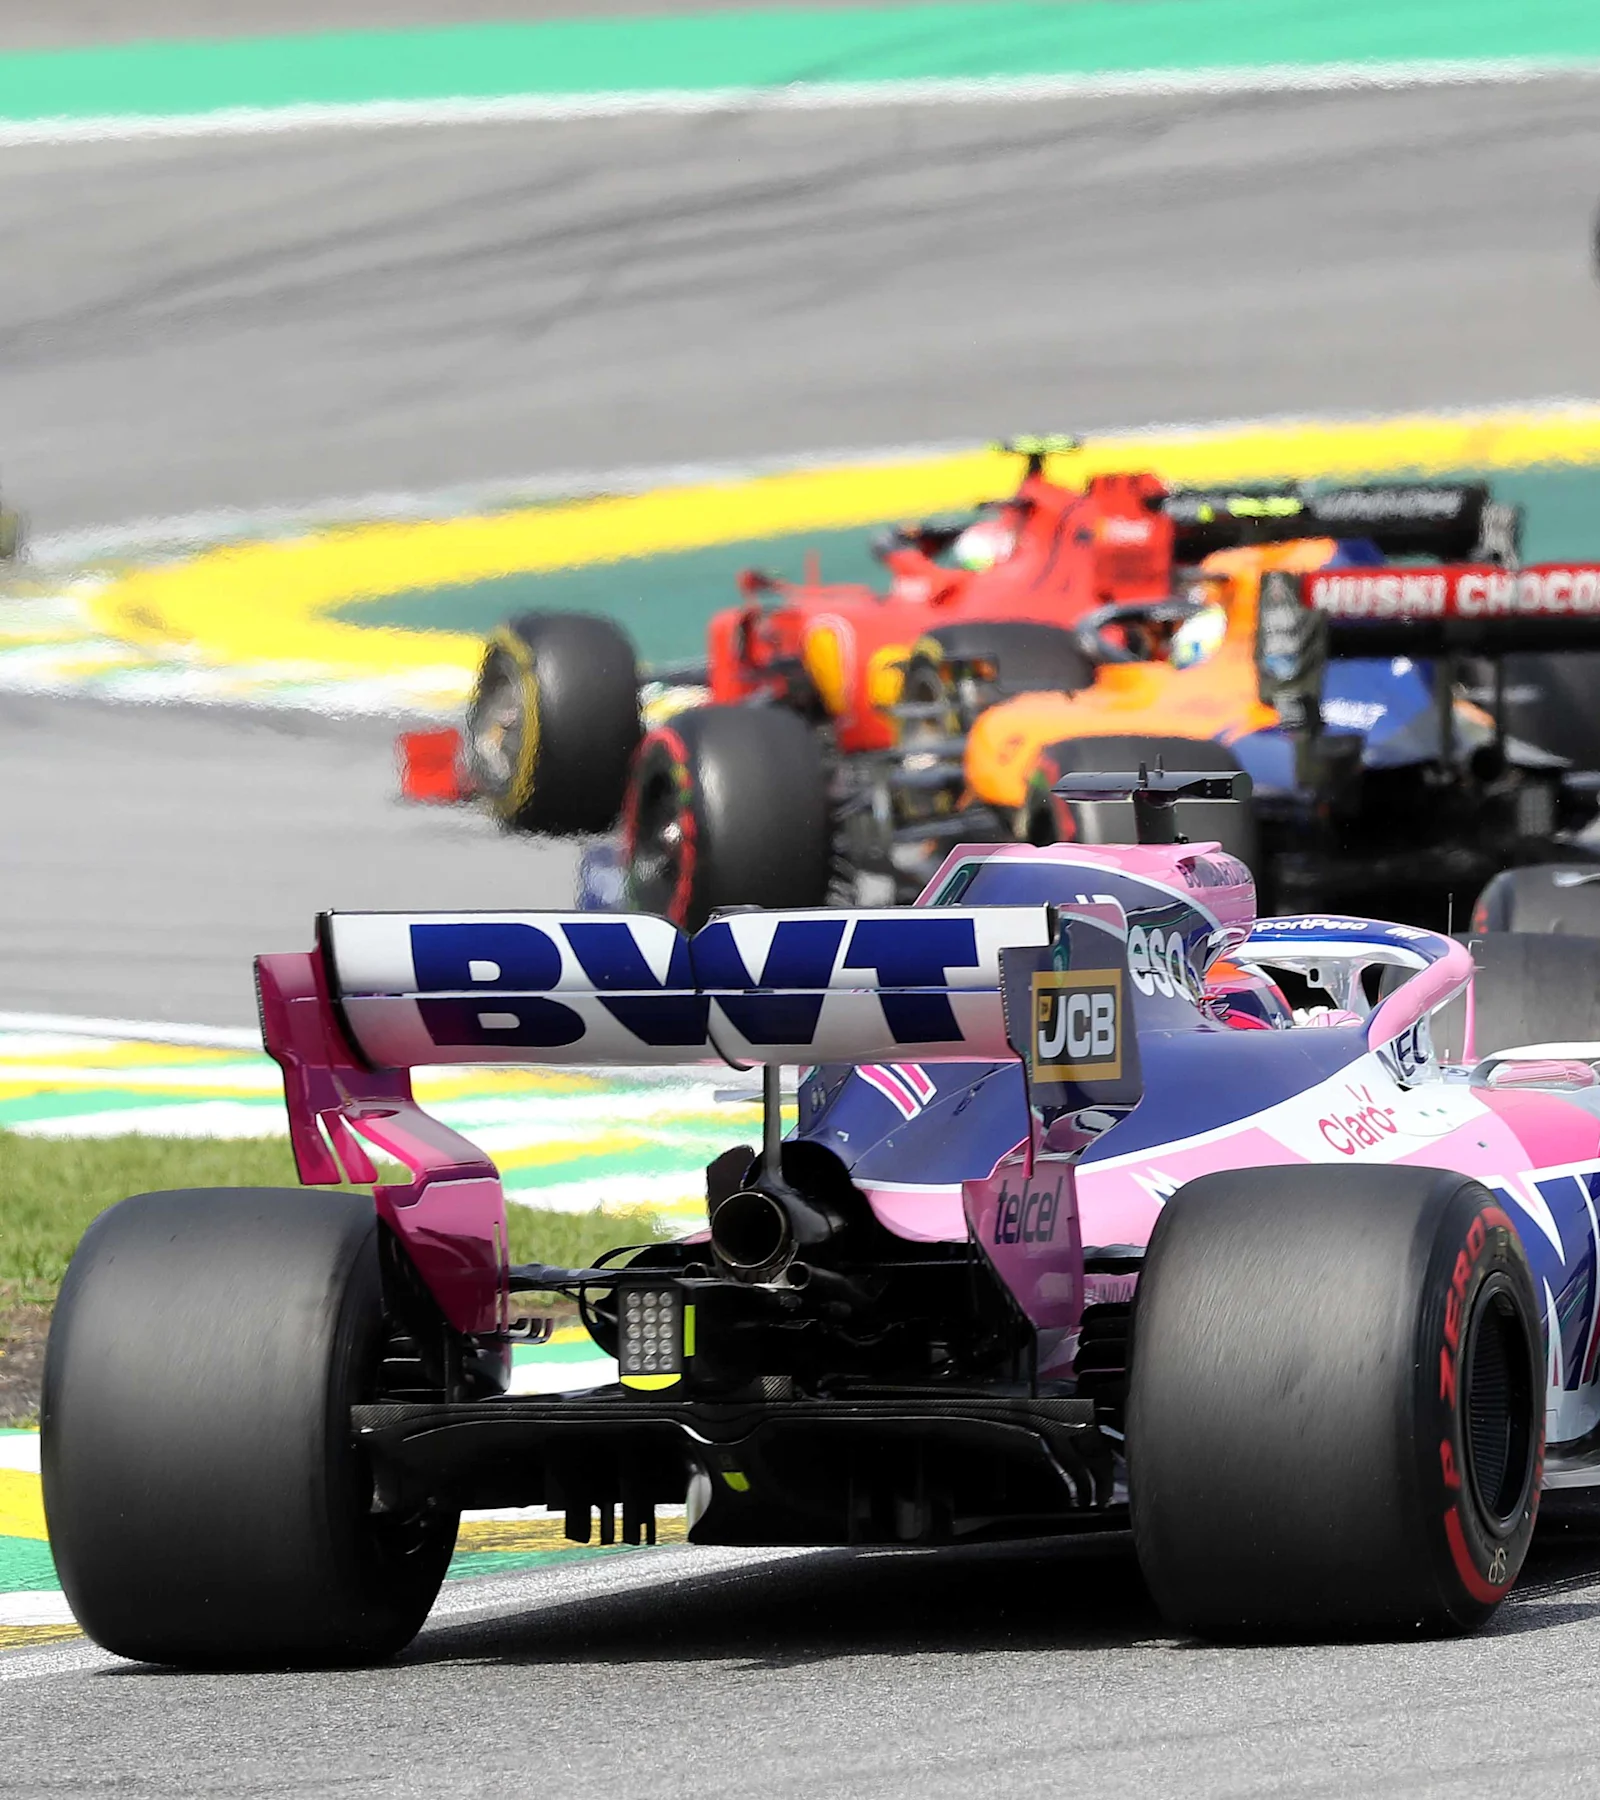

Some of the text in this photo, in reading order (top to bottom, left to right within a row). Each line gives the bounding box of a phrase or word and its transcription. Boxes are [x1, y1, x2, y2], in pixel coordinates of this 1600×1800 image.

[1312, 573, 1448, 616] HUSKI
[409, 918, 980, 1046] BWT
[1037, 992, 1116, 1059] JCB
[1375, 1016, 1429, 1082] NEC
[1318, 1105, 1398, 1156] Claro
[994, 1175, 1064, 1245] telcel
[1440, 1214, 1486, 1410] ZERO
